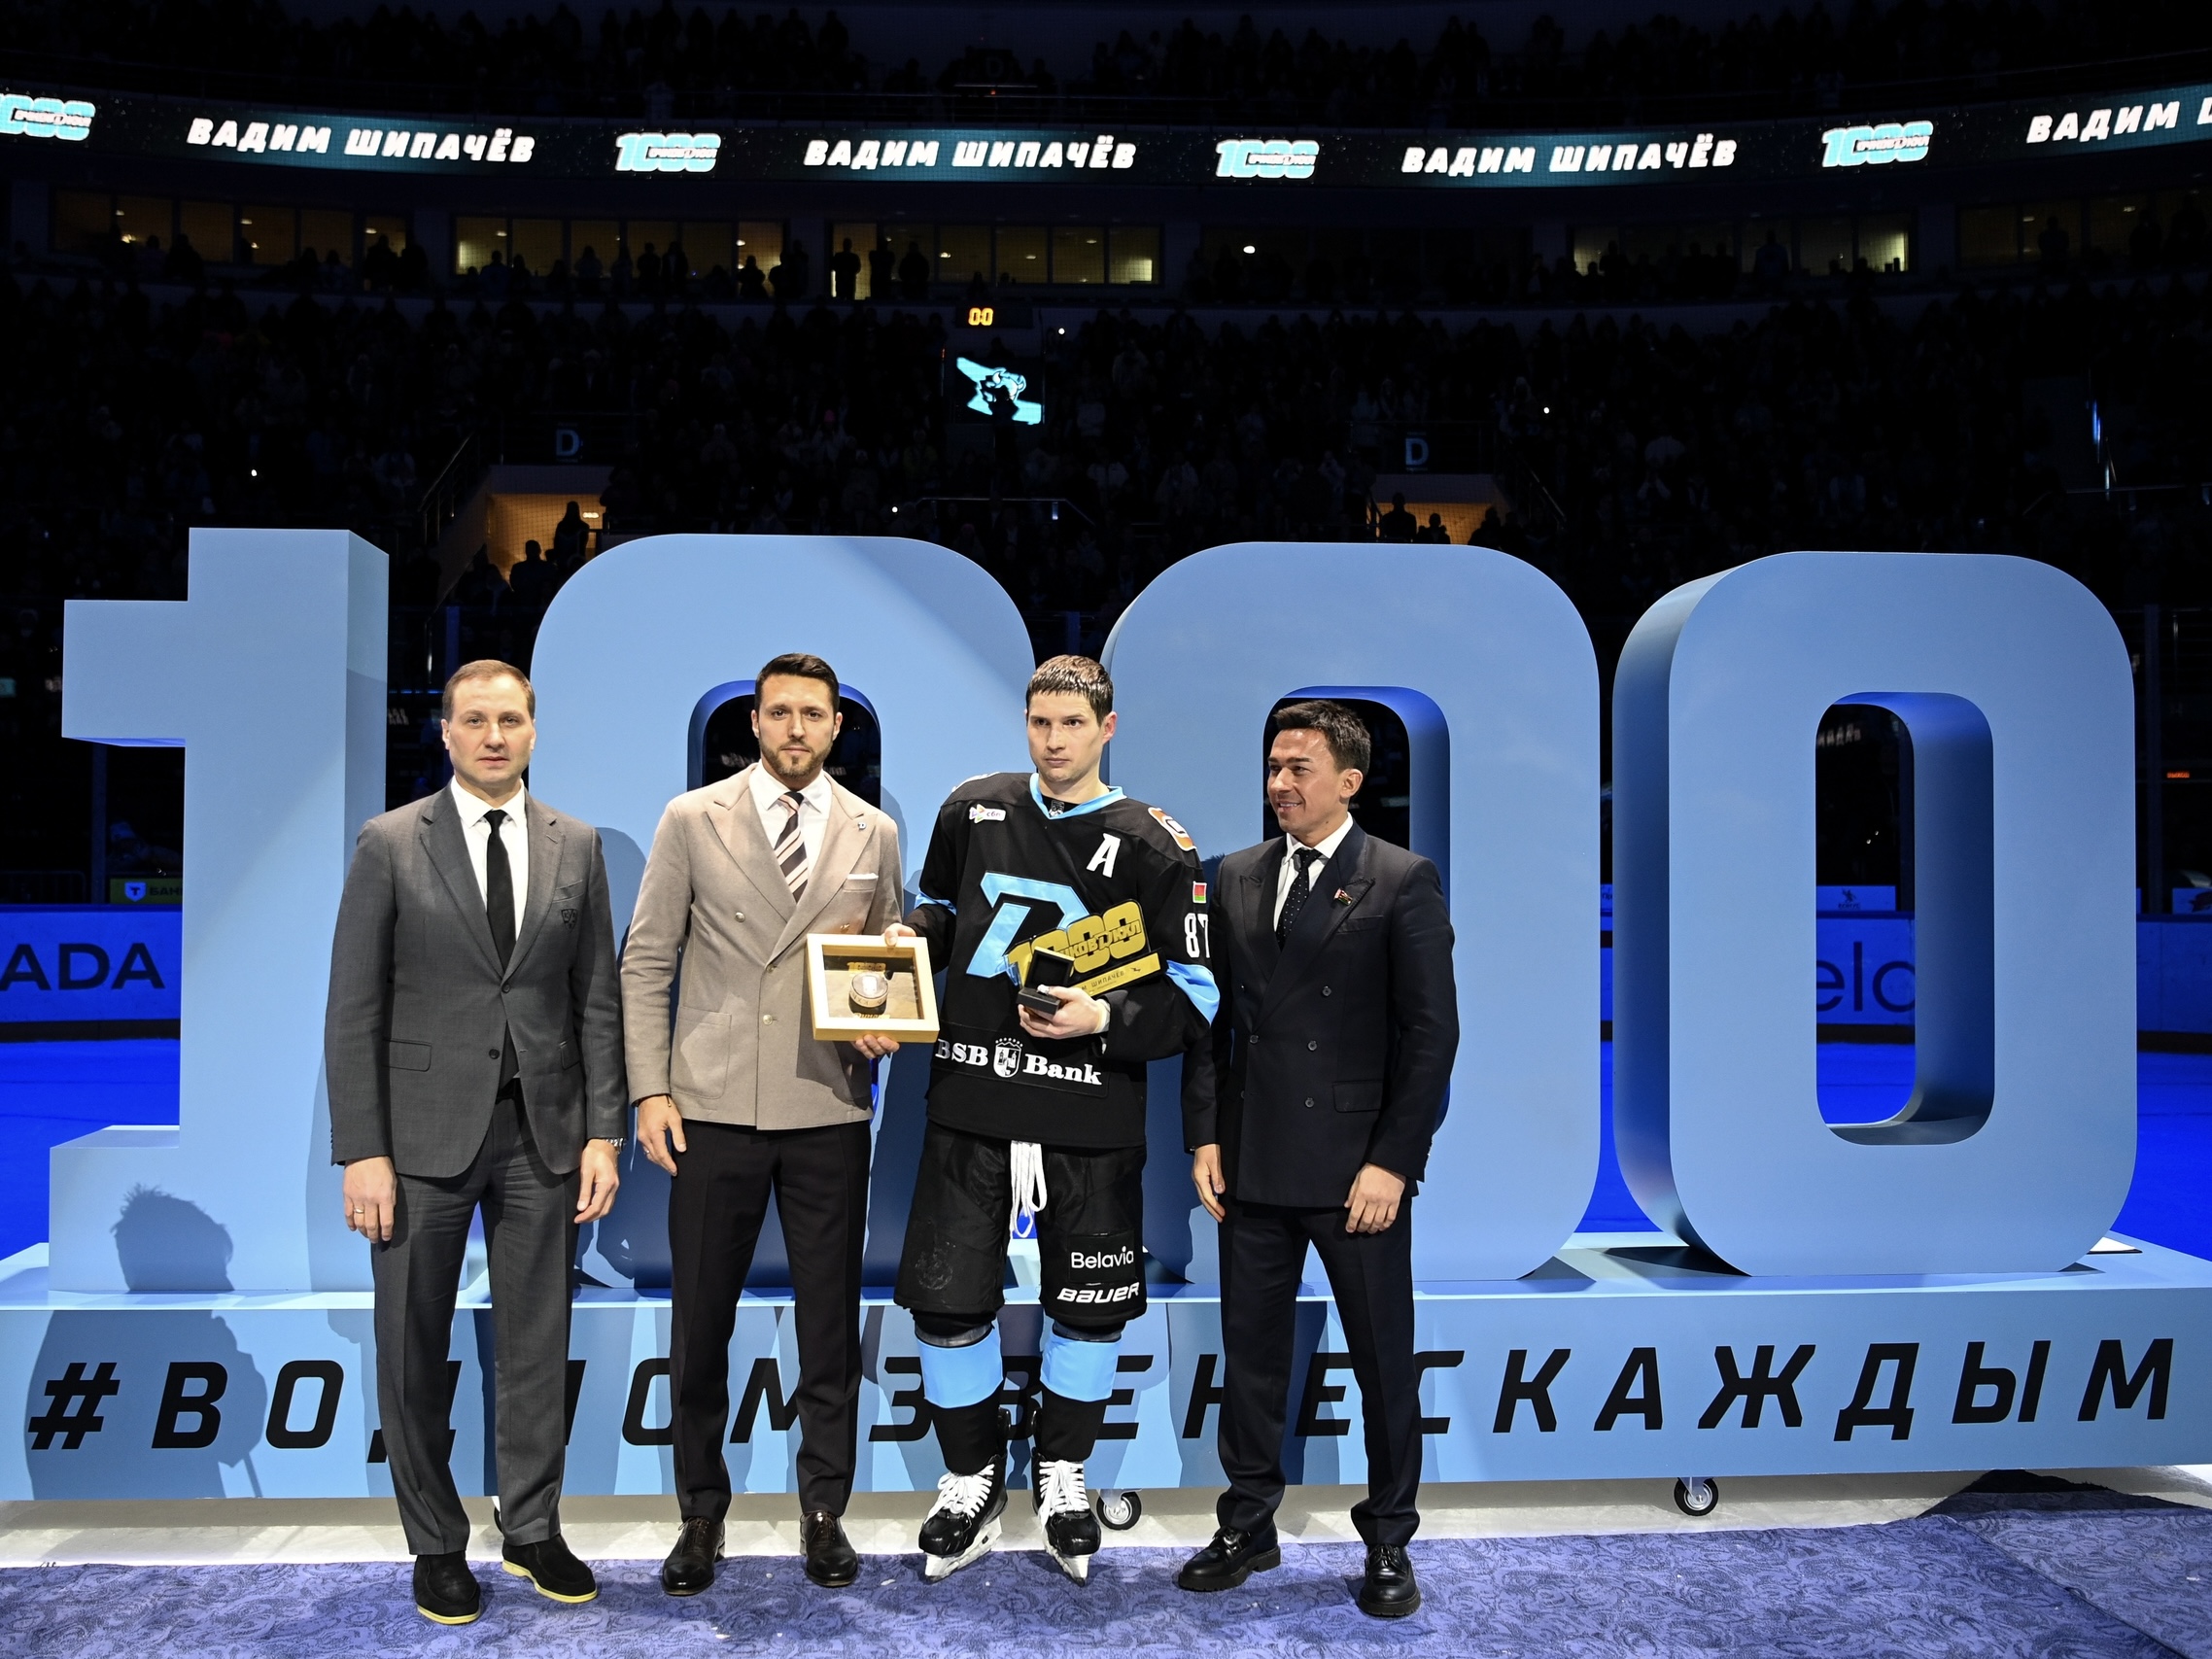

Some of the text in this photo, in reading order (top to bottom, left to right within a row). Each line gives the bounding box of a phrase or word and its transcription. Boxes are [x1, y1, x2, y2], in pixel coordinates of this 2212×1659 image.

[188, 118, 536, 162] ВАДИМ ШИПАЧЁВ
[2026, 100, 2181, 144] ВАДИМ
[804, 134, 1137, 170] ВАДИМ ШИПАЧЁВ
[1401, 133, 1738, 178] ВАДИМ ШИПАЧЁВ
[556, 429, 580, 456] D
[1405, 437, 1430, 466] D
[1086, 832, 1122, 879] A
[150, 886, 183, 896] БАН
[1184, 913, 1211, 958] 87
[0, 943, 165, 991] ADA
[935, 1038, 1102, 1086] BSB Bank
[1070, 1245, 1134, 1269] Belavia
